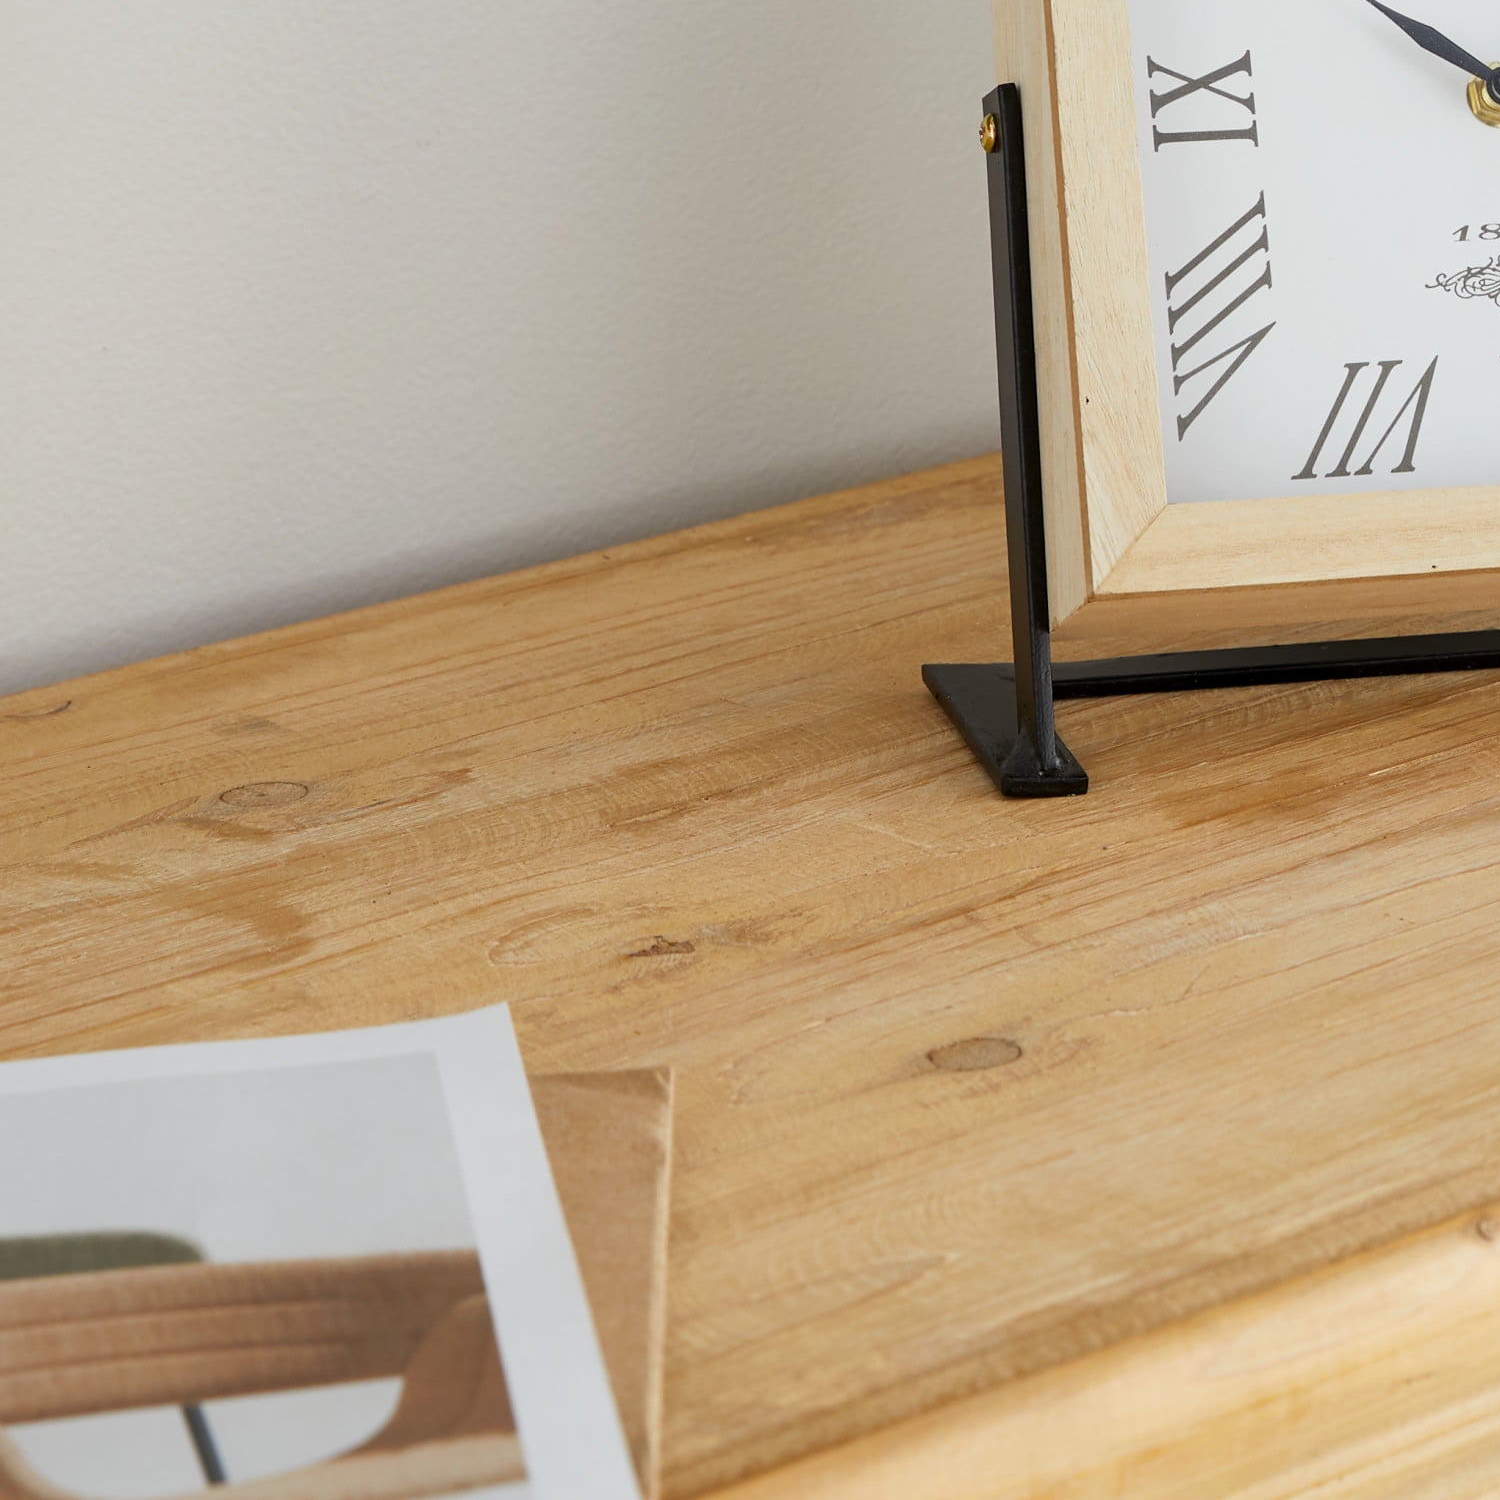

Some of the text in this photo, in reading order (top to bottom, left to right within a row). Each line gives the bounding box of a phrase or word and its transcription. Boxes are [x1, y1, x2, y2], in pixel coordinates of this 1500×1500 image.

[1147, 49, 1259, 153] IX
[1165, 190, 1276, 442] VIII
[1291, 355, 1438, 480] VII
